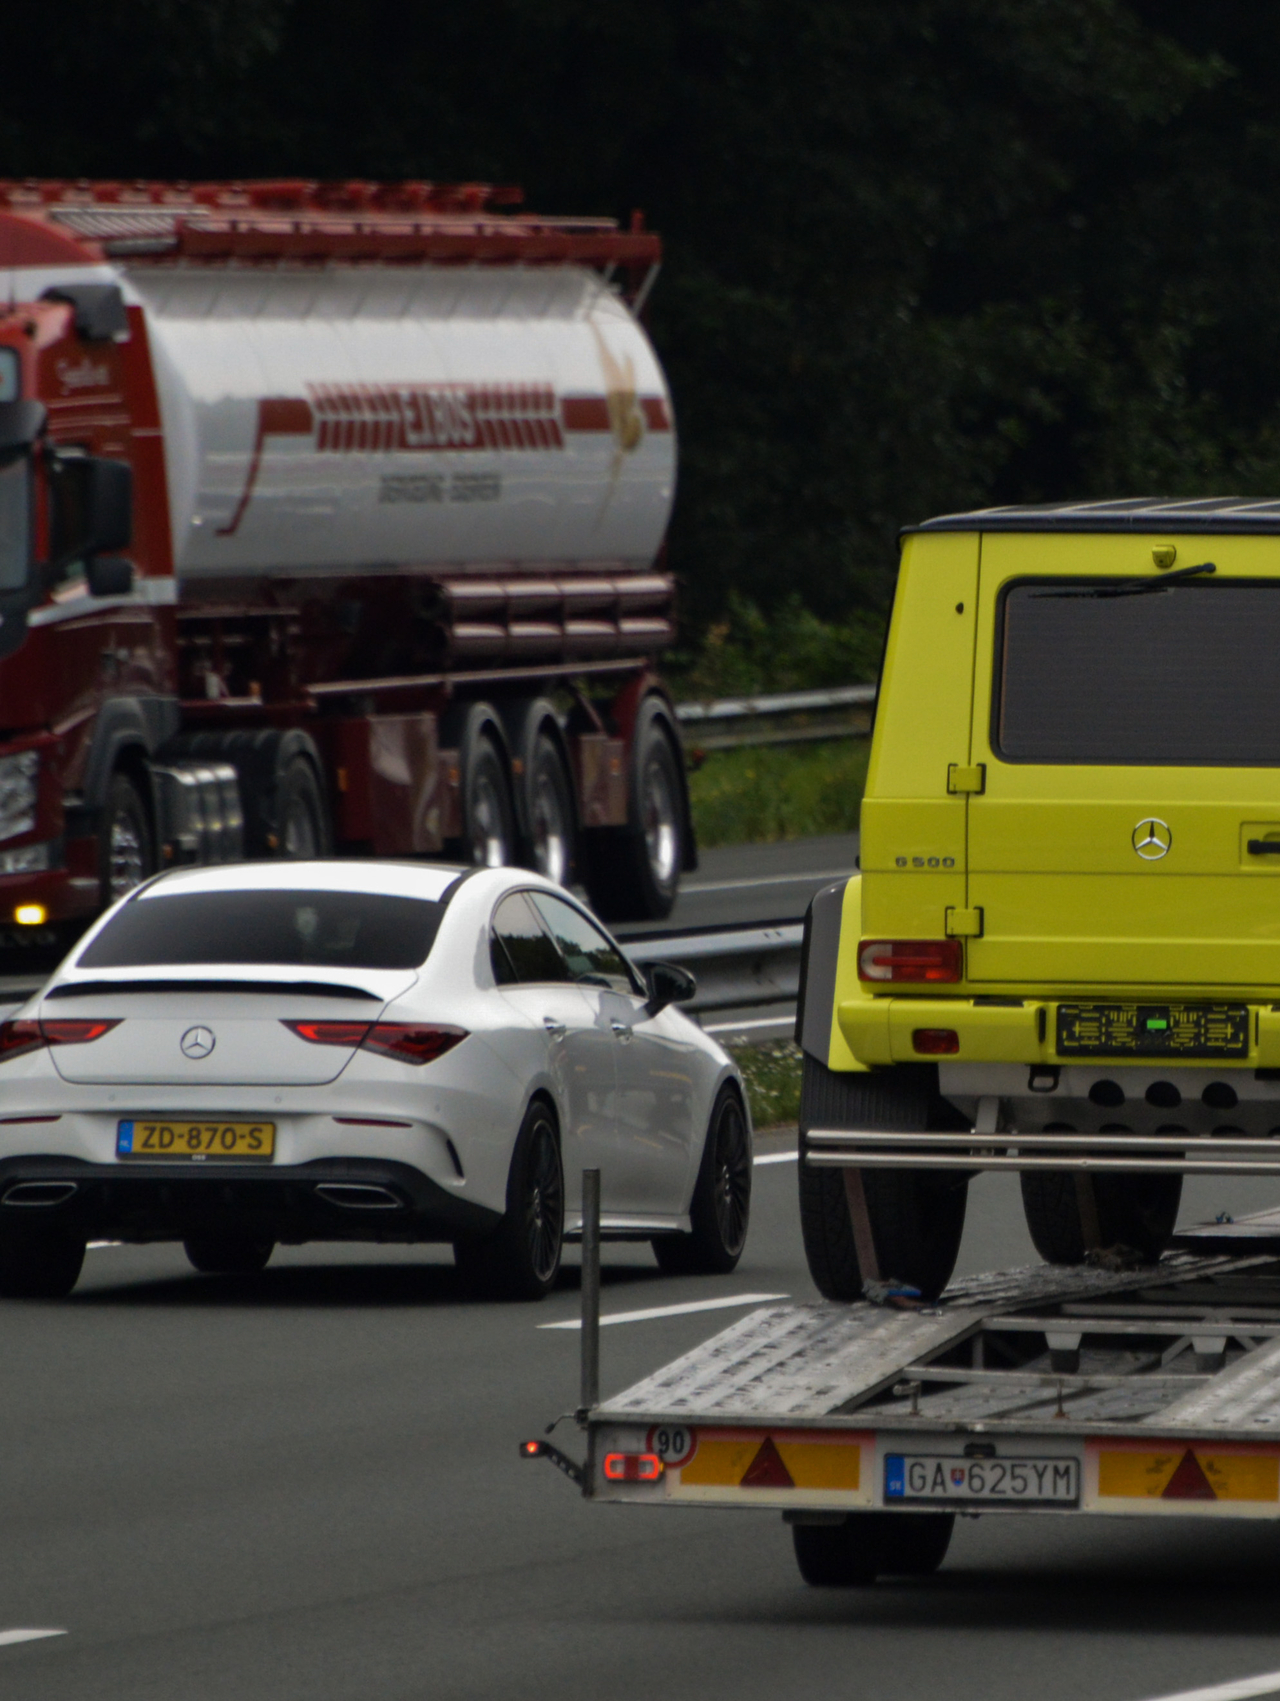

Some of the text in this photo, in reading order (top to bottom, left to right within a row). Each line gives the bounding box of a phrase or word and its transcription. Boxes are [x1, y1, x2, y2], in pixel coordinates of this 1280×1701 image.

[912, 856, 955, 868] 500
[141, 1126, 263, 1151] ZD-870-S
[658, 1430, 685, 1455] 90
[908, 1462, 1072, 1496] GA 625YM
